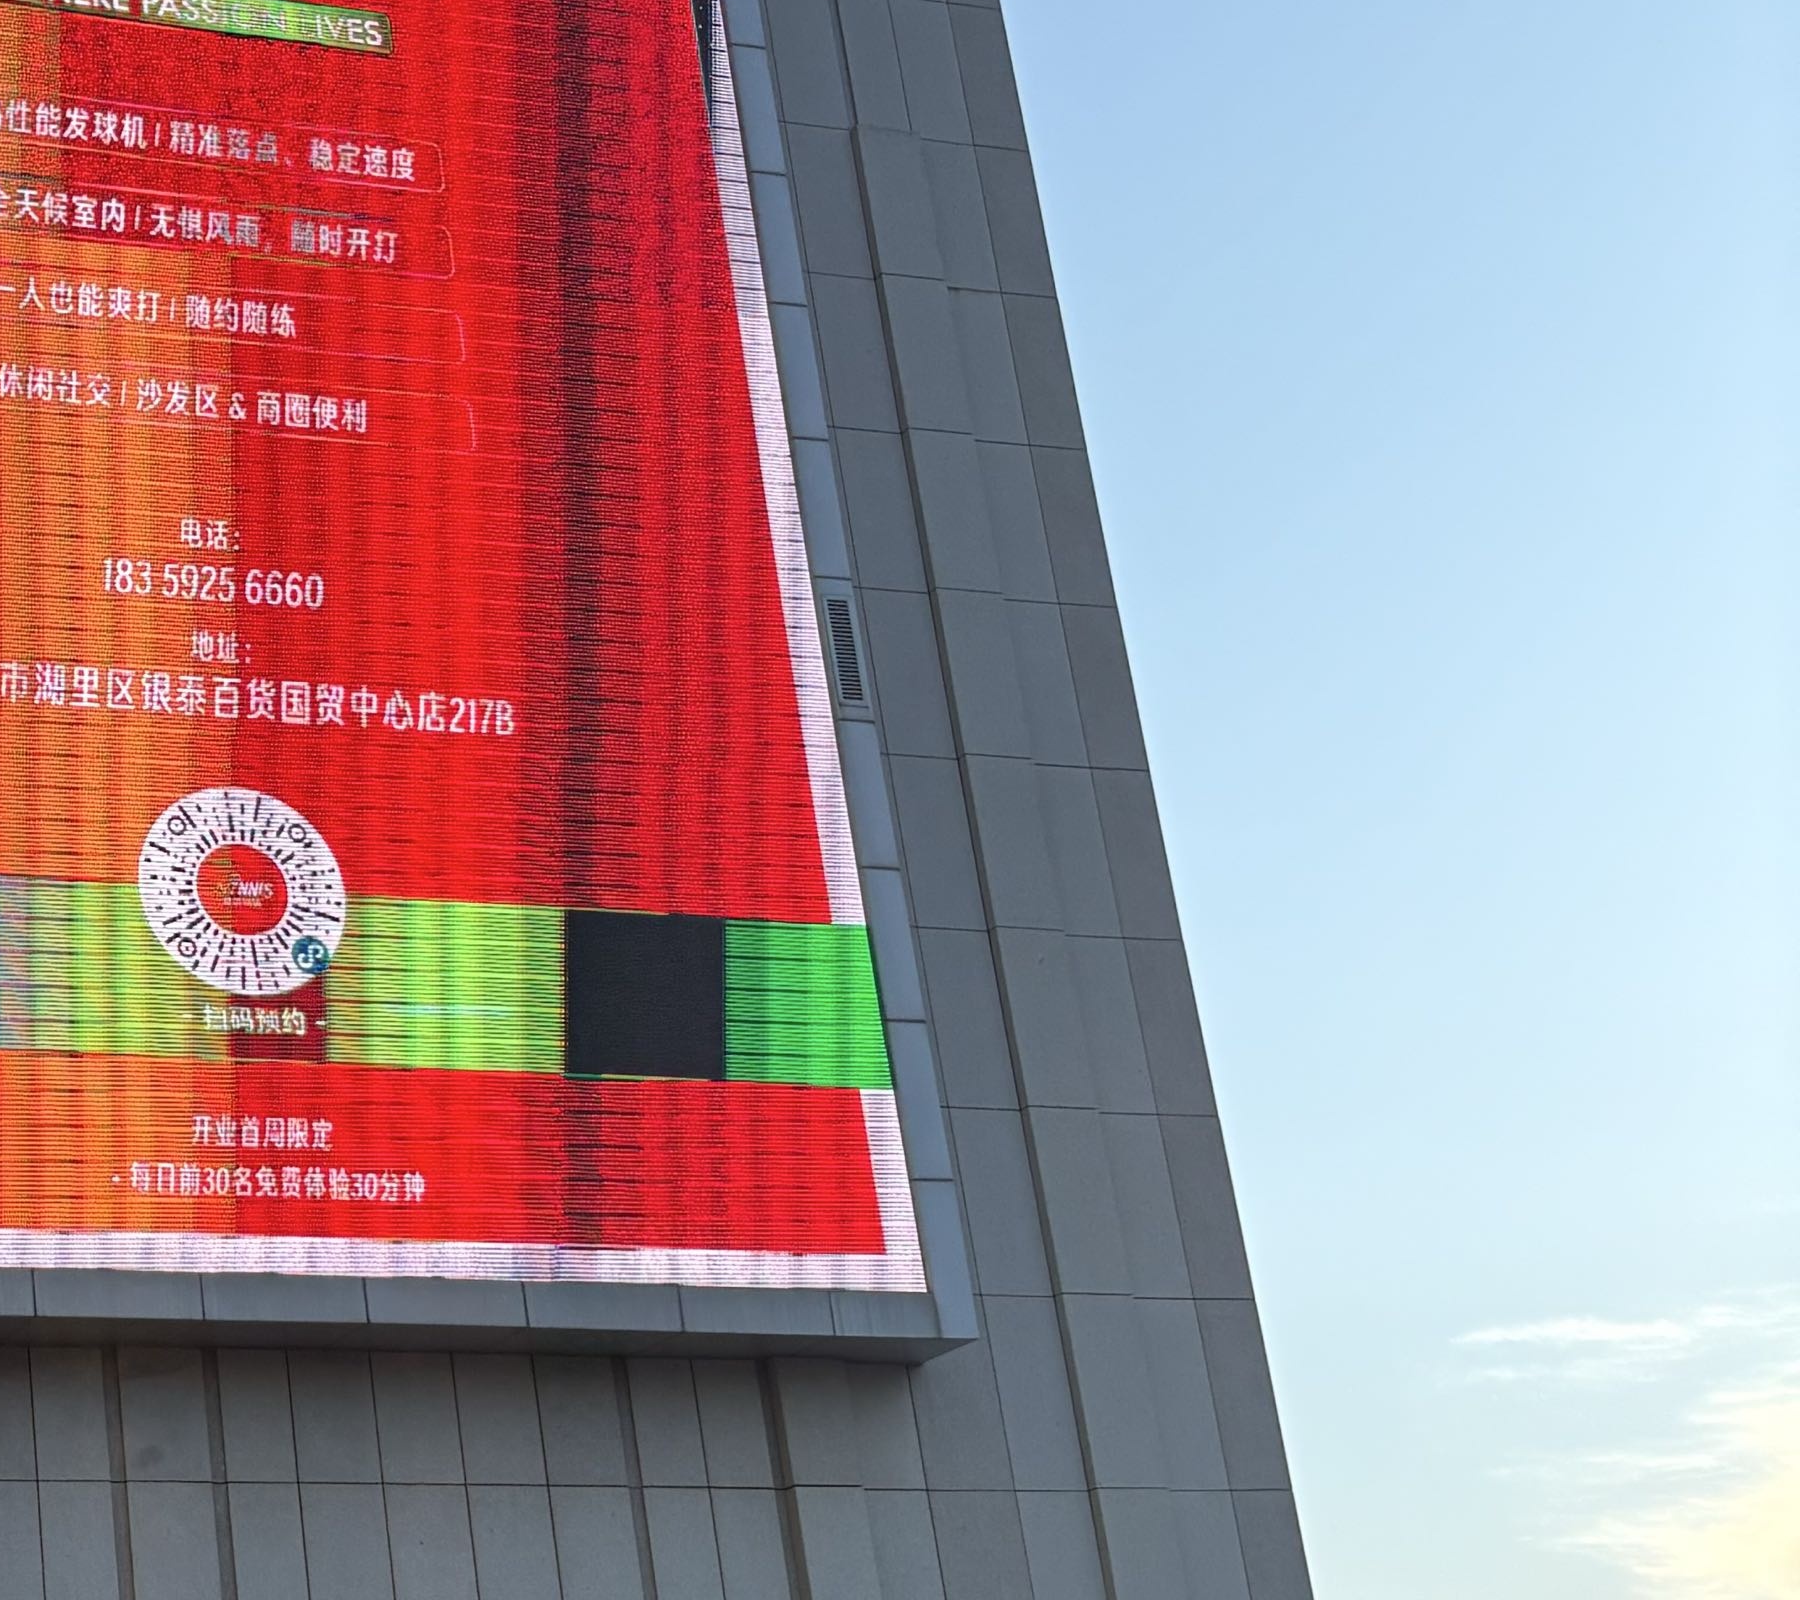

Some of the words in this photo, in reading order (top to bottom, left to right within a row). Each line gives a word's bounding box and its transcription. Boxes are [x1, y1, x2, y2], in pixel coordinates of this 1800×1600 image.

[300, 12, 384, 47] LIVES
[185, 295, 297, 338] 随约随练
[136, 377, 219, 417] 沙发区
[256, 391, 367, 433] 商圈便利
[104, 558, 153, 596] 183
[163, 563, 236, 603] 5925
[245, 570, 324, 610] 6660
[192, 1116, 333, 1151] 开业首周限定
[130, 1161, 426, 1203] 每日前30名免费体验30分钟
